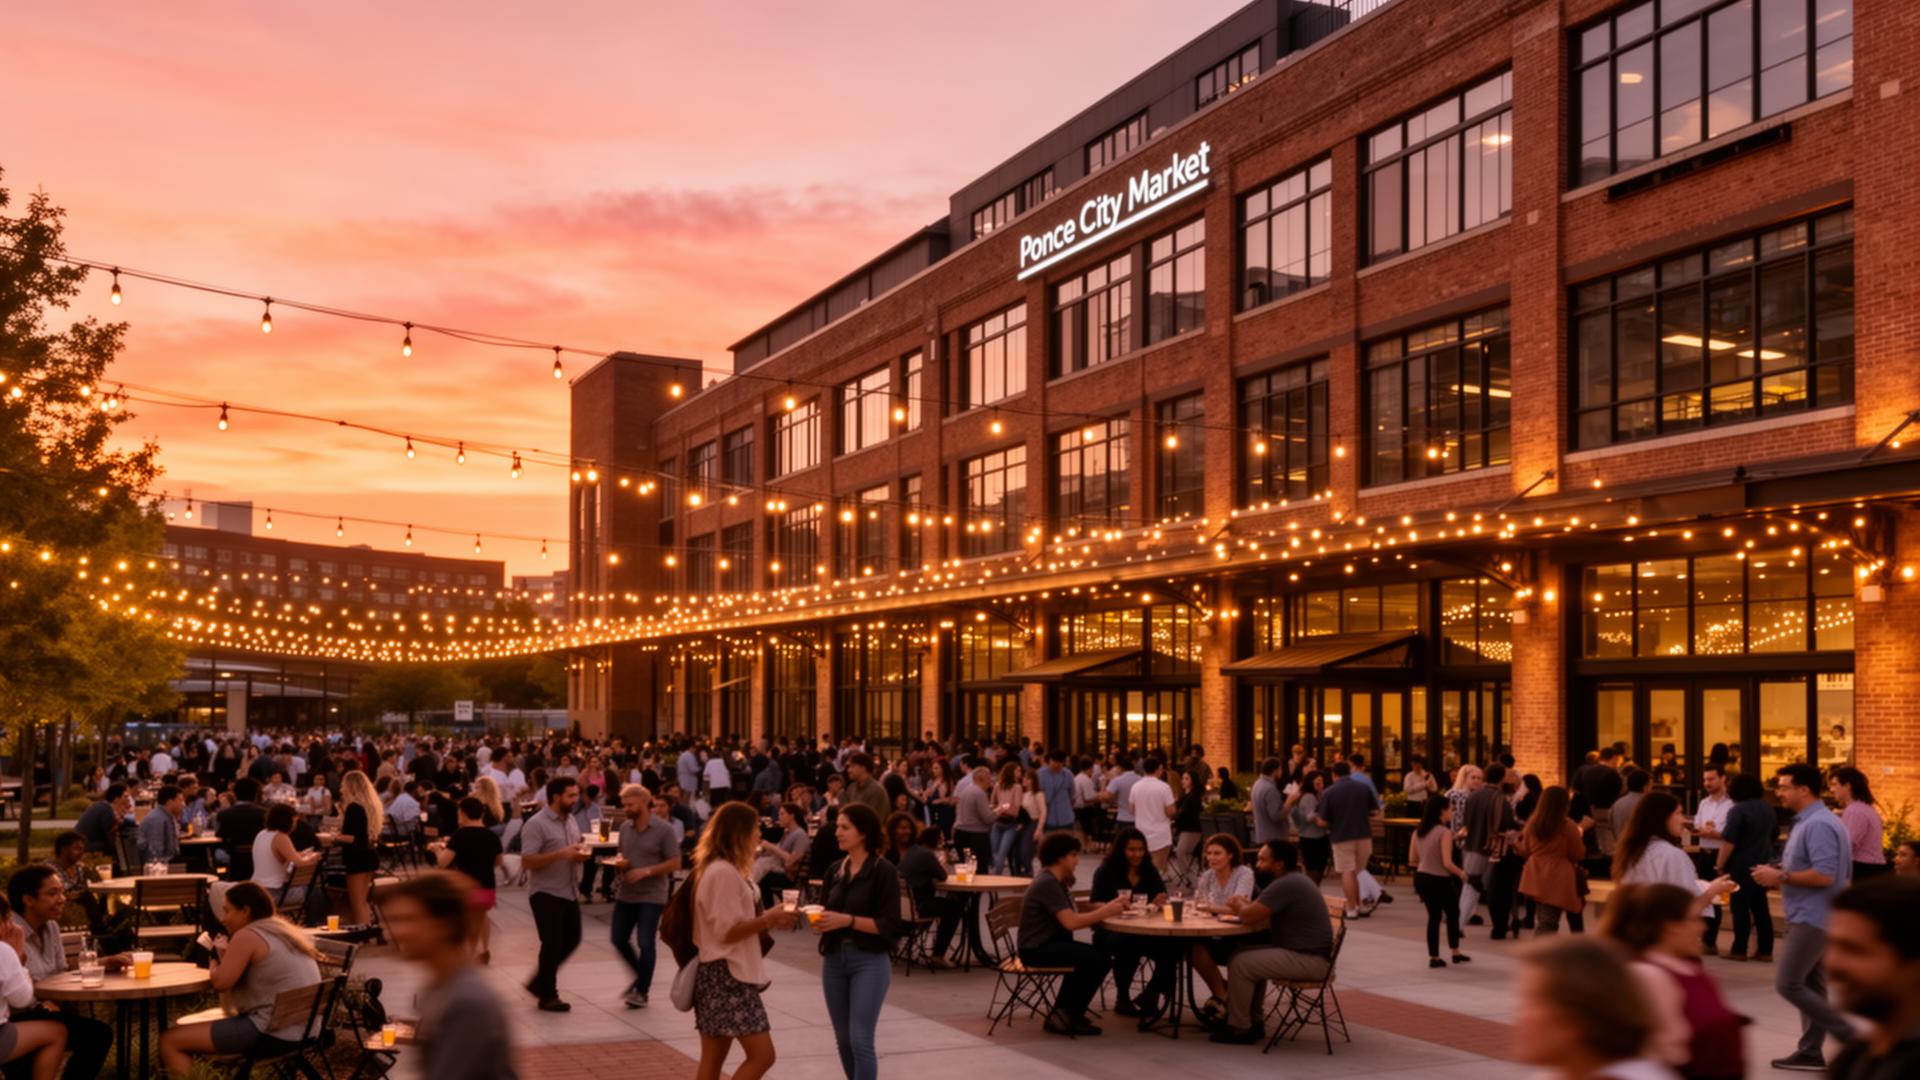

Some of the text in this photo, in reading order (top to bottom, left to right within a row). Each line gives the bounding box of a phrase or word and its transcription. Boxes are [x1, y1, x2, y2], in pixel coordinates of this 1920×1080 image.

[1020, 141, 1210, 268] Ponce City Market
